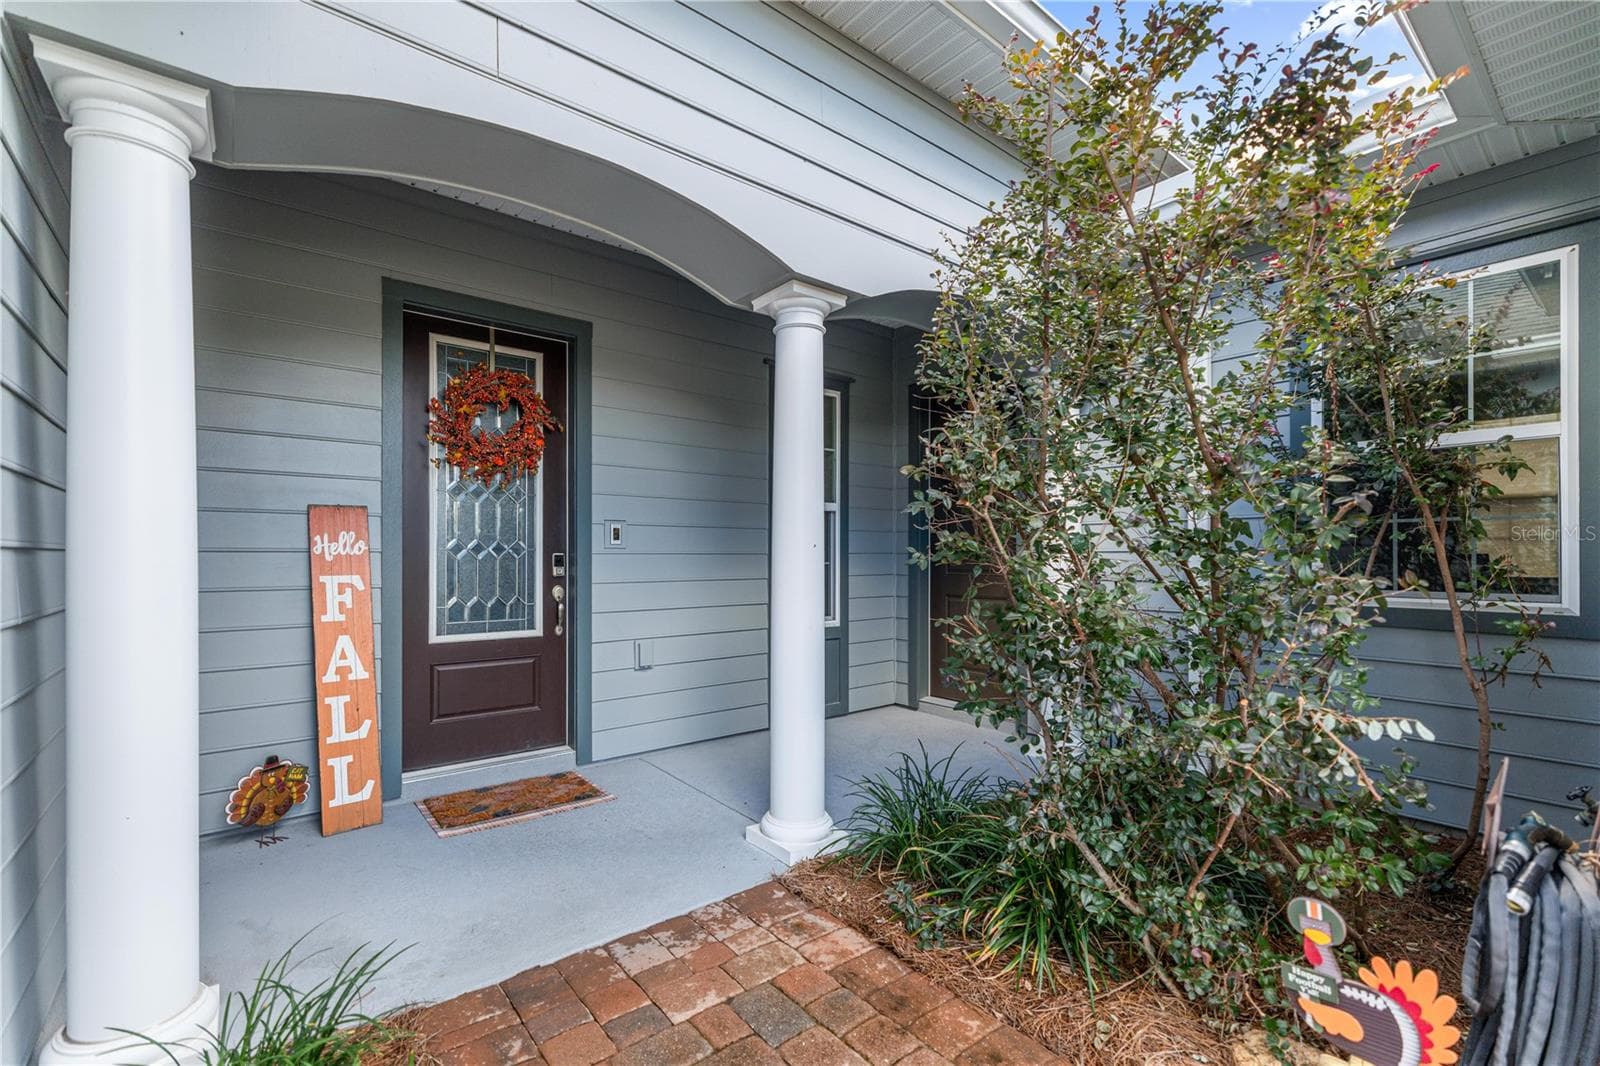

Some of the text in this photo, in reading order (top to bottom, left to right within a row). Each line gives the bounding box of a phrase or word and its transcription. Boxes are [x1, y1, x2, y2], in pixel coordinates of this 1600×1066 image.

[313, 531, 368, 561] Hello
[319, 575, 375, 808] FALL
[1287, 973, 1332, 995] Football
[1291, 965, 1325, 985] Happy
